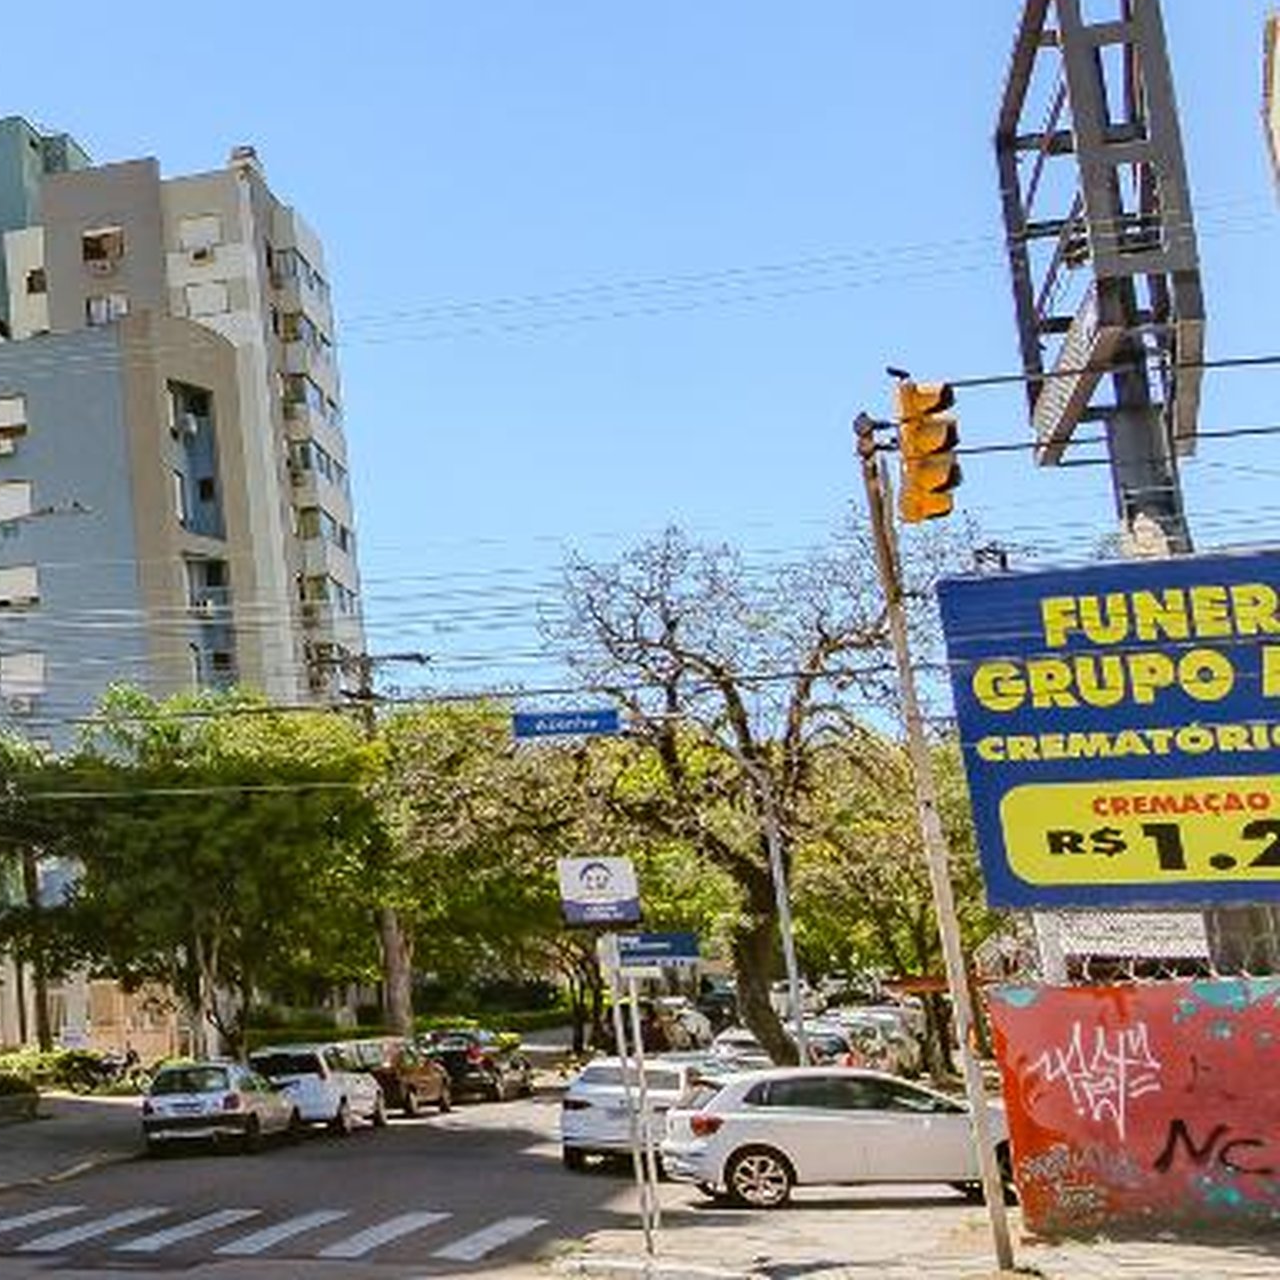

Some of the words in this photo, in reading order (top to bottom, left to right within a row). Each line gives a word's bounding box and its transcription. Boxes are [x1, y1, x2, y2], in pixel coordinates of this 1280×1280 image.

[1042, 584, 1280, 647] FUNER
[972, 648, 1235, 711] GRUPO
[976, 722, 1280, 761] CREMATÓRI
[1046, 827, 1128, 857] R$
